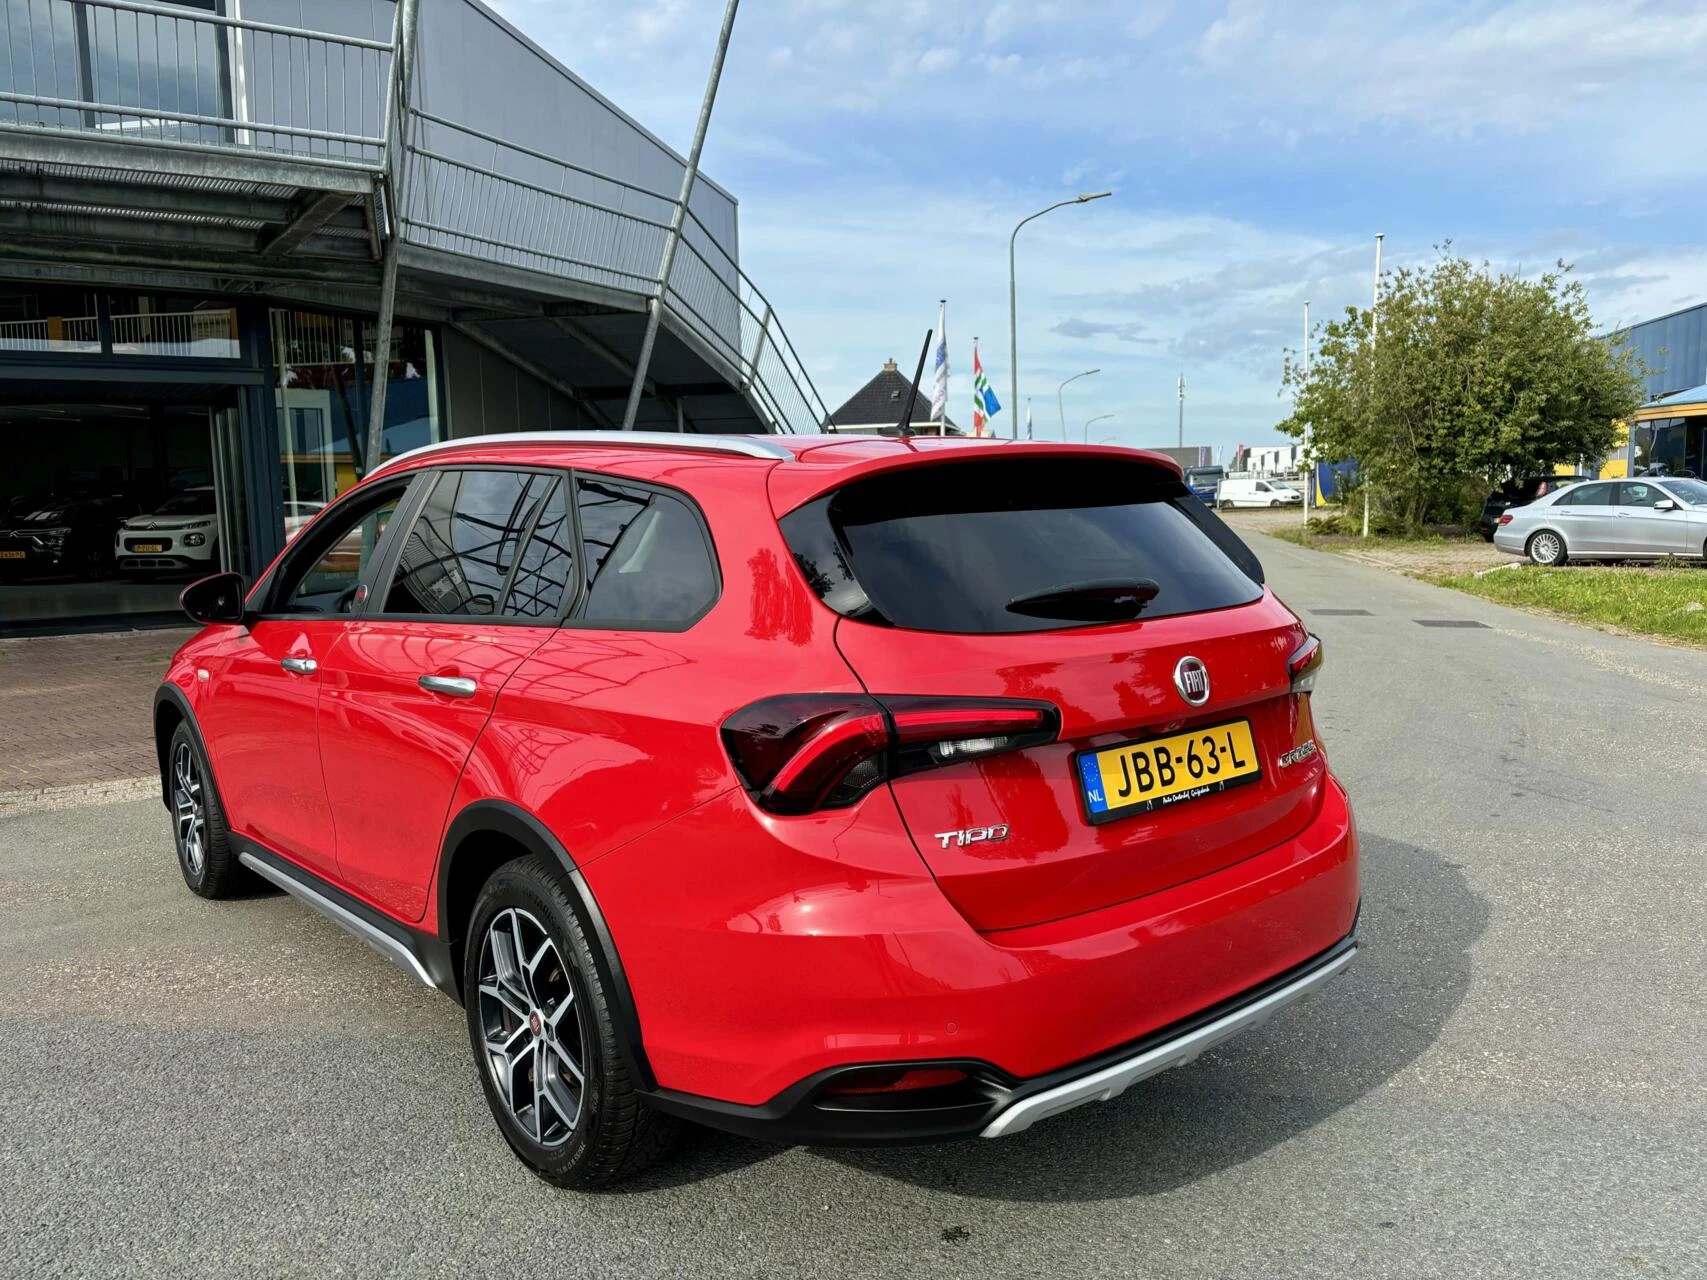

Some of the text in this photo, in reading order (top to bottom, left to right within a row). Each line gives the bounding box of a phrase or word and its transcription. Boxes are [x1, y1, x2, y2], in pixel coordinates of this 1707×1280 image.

[1184, 669, 1206, 693] FIAT
[1117, 731, 1246, 798] JBB-63-L
[1088, 790, 1104, 803] NL
[934, 823, 1009, 849] TIPO
